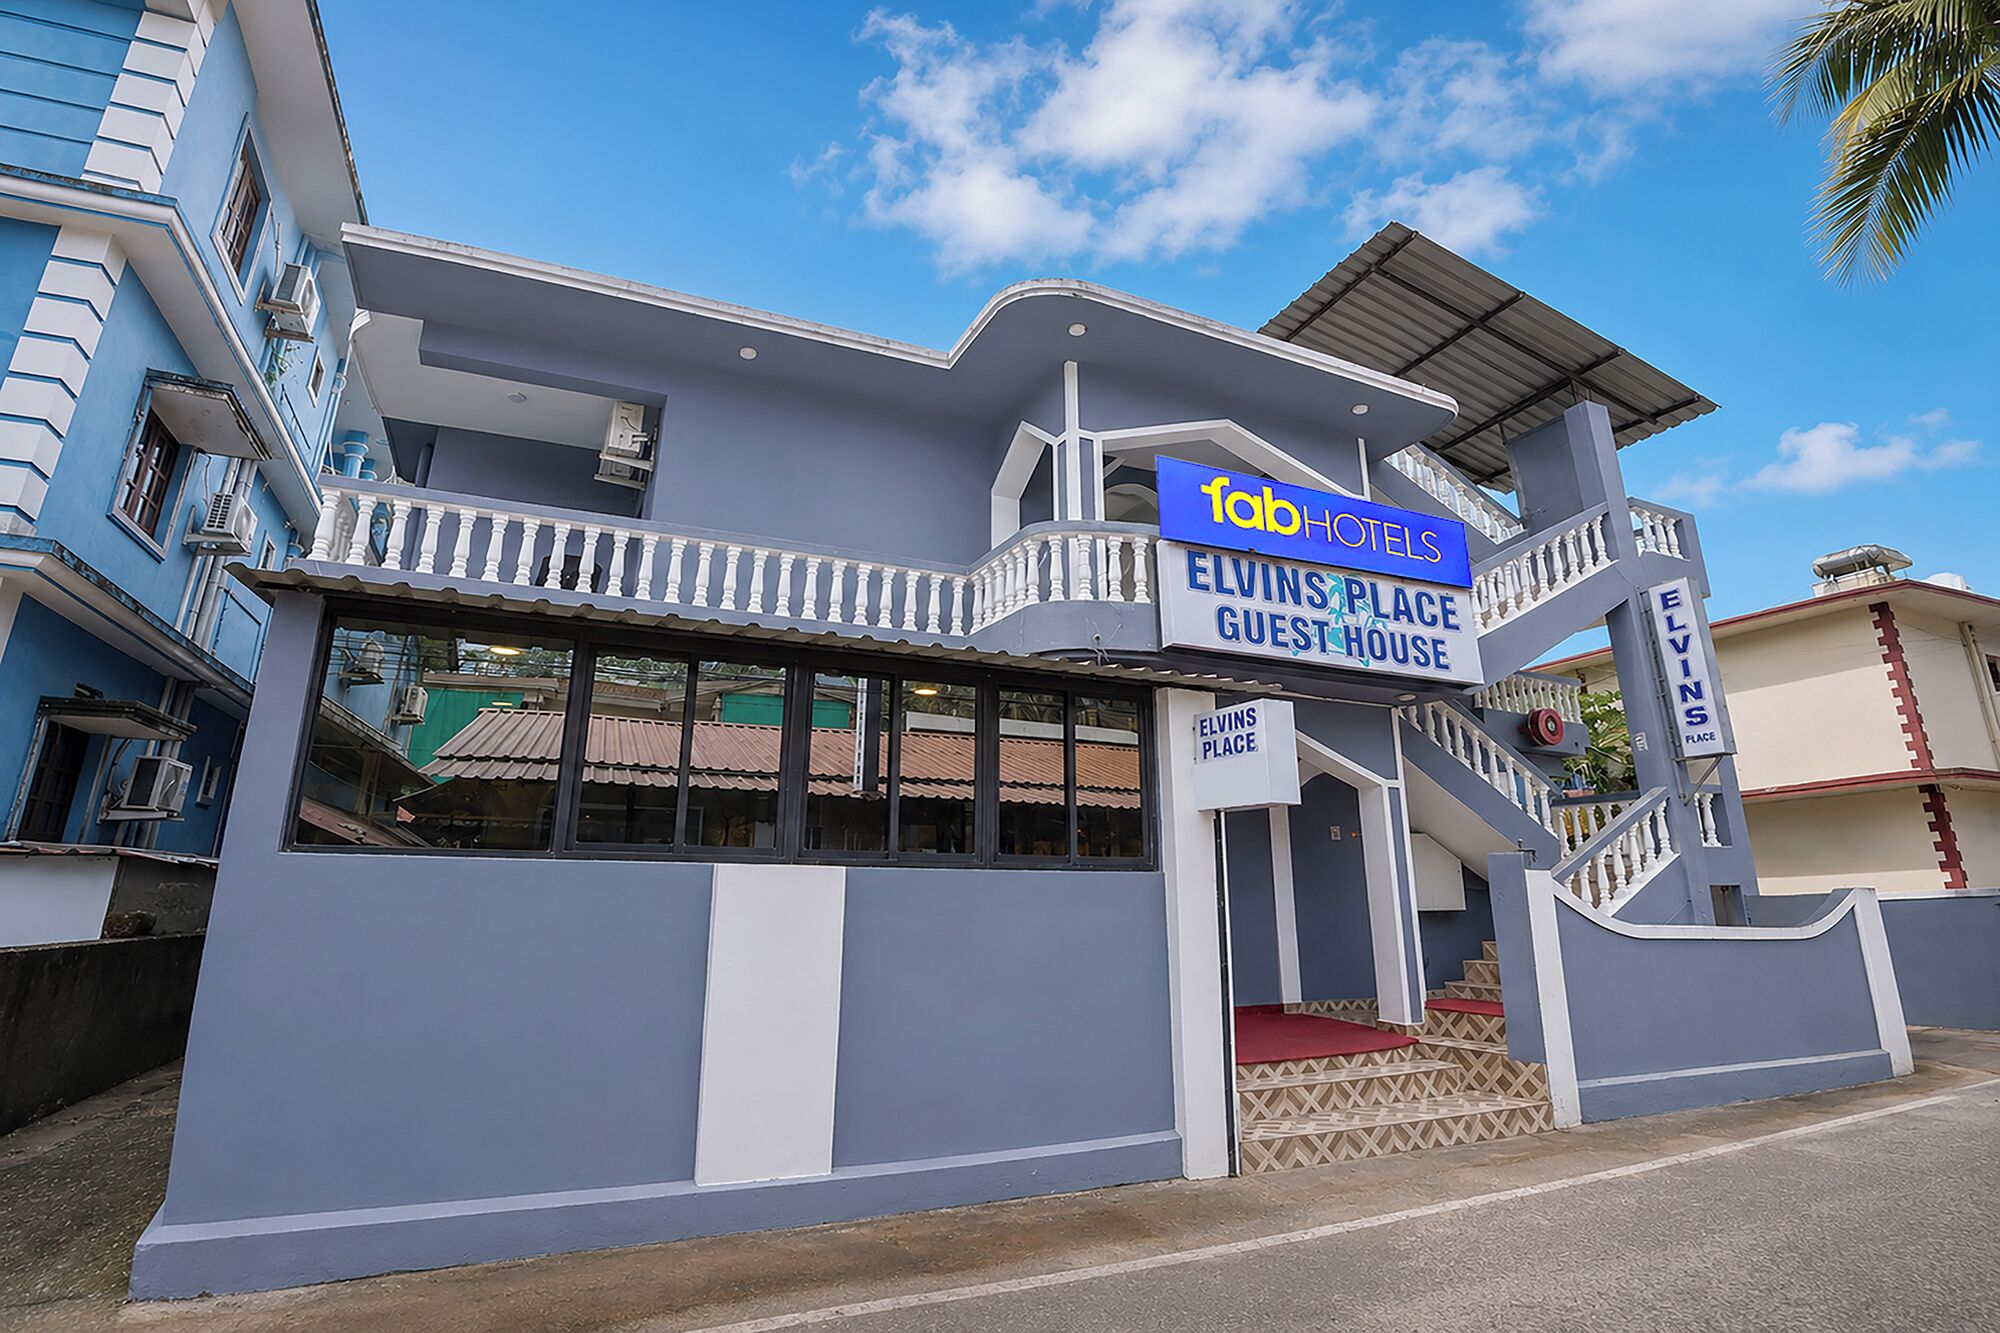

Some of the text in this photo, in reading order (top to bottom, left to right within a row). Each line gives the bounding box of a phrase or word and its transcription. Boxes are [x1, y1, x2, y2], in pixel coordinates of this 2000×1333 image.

[1188, 551, 1460, 631] ELVINS PLACE
[1218, 606, 1450, 670] GUEST HOUSE
[1660, 589, 1708, 726] ELVINS
[1199, 706, 1257, 738] ELVINS
[1202, 732, 1256, 760] PLACE
